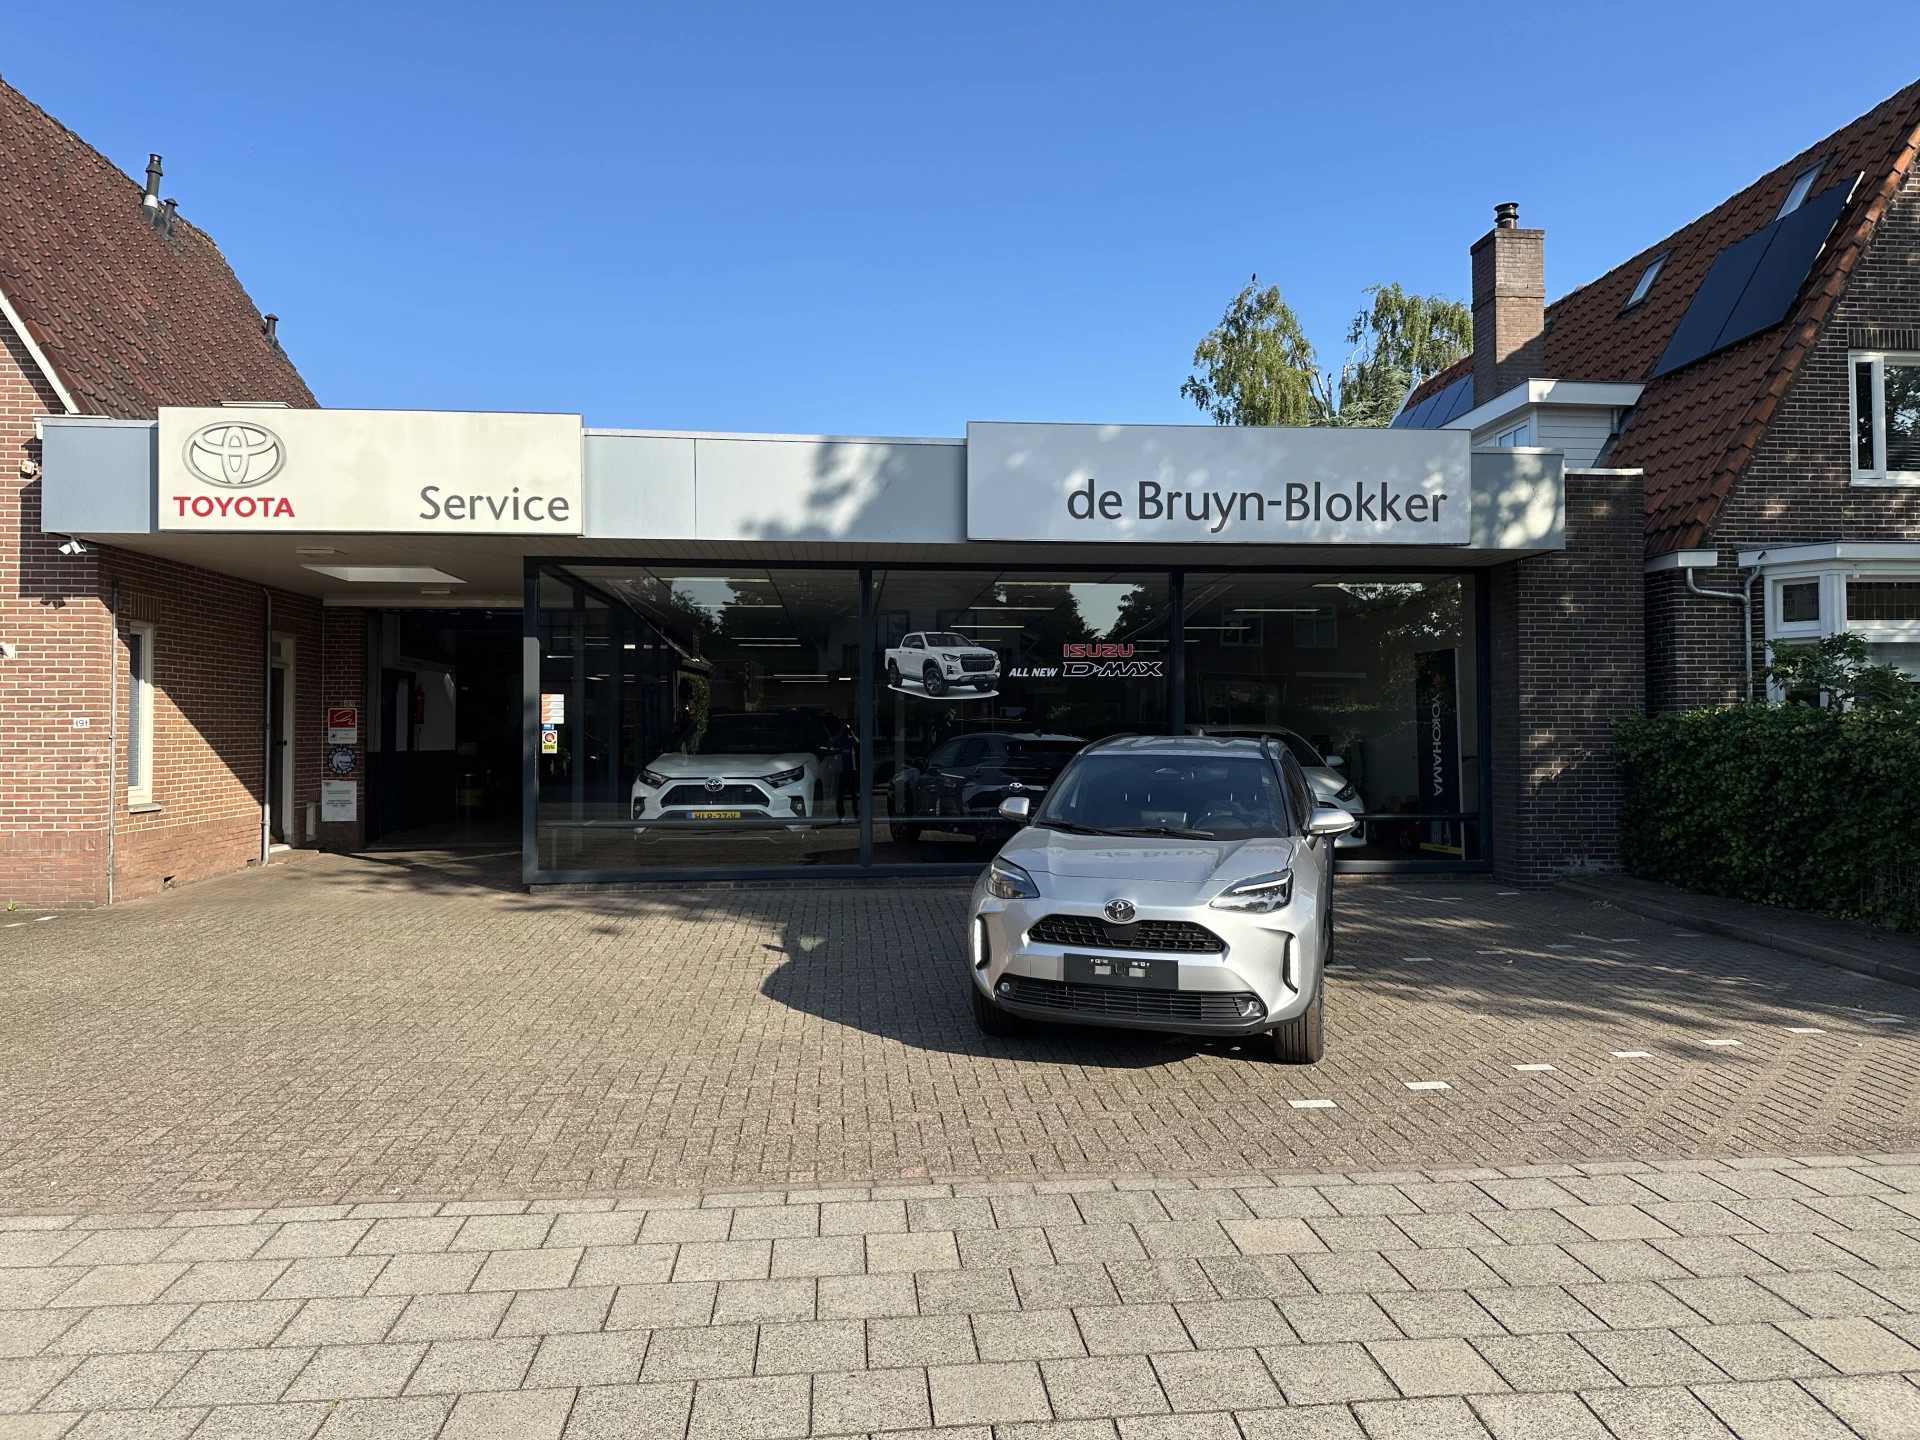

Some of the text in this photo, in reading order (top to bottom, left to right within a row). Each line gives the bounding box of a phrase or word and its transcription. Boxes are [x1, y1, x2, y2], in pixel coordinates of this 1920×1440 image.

[173, 496, 295, 518] TOYOTA
[419, 485, 570, 522] Service
[1067, 479, 1447, 533] de Bruyn-Blokker
[1063, 643, 1134, 658] ISUZU
[1008, 667, 1030, 677] ALL
[1031, 667, 1058, 677] NEW
[1431, 693, 1443, 797] YOKOHAMA
